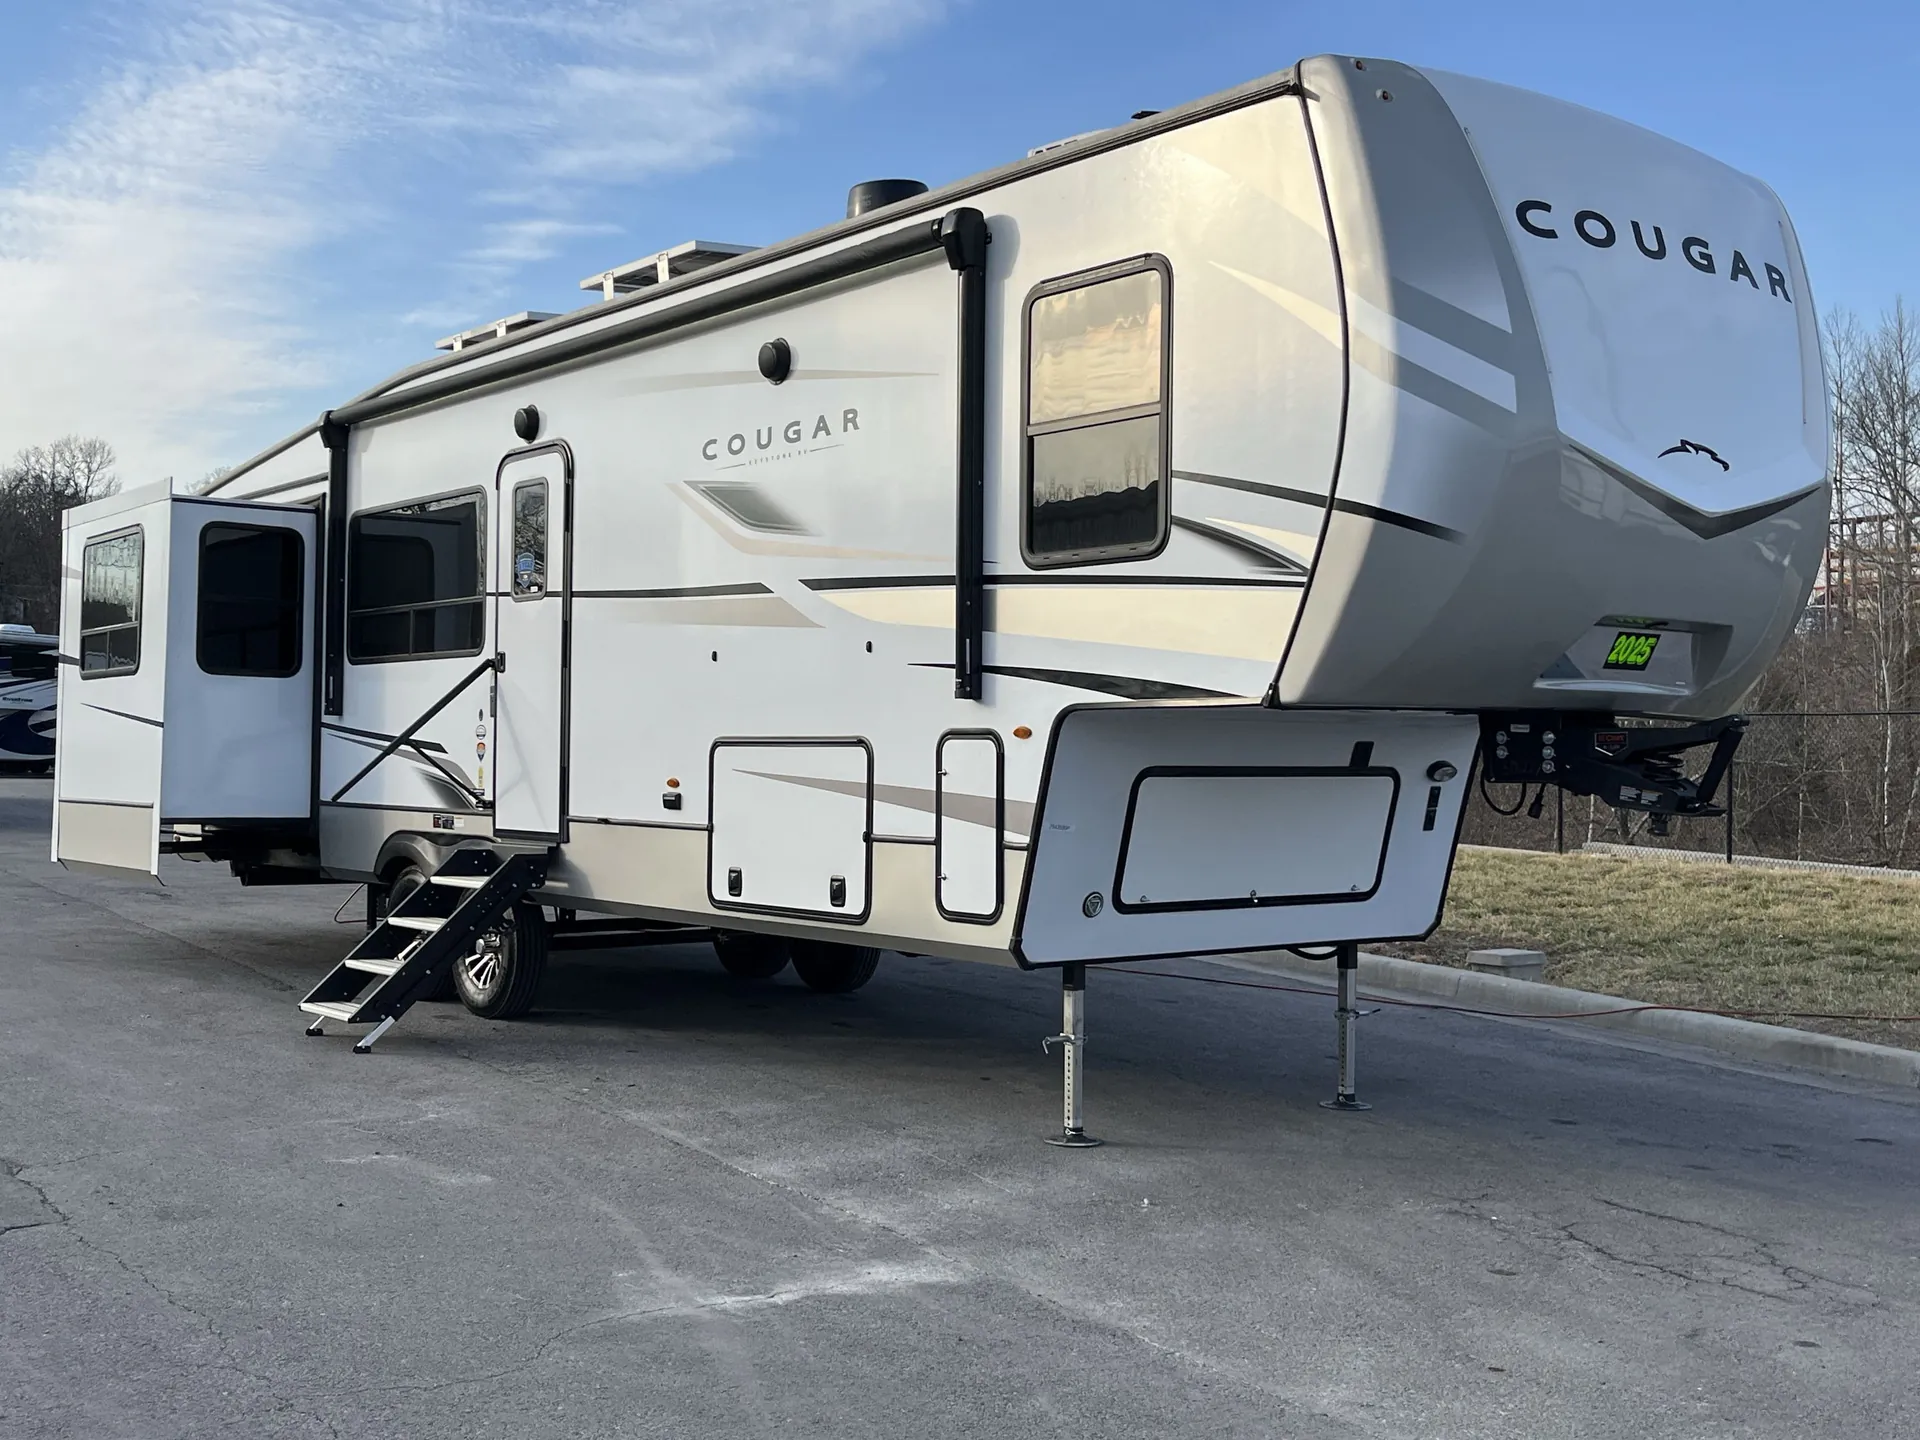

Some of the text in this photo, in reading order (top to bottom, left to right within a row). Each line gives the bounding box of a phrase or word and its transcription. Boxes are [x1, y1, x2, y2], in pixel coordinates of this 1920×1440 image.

[1515, 200, 1792, 303] COUGAR
[702, 408, 859, 460] COUGAR
[1607, 634, 1658, 665] 2025
